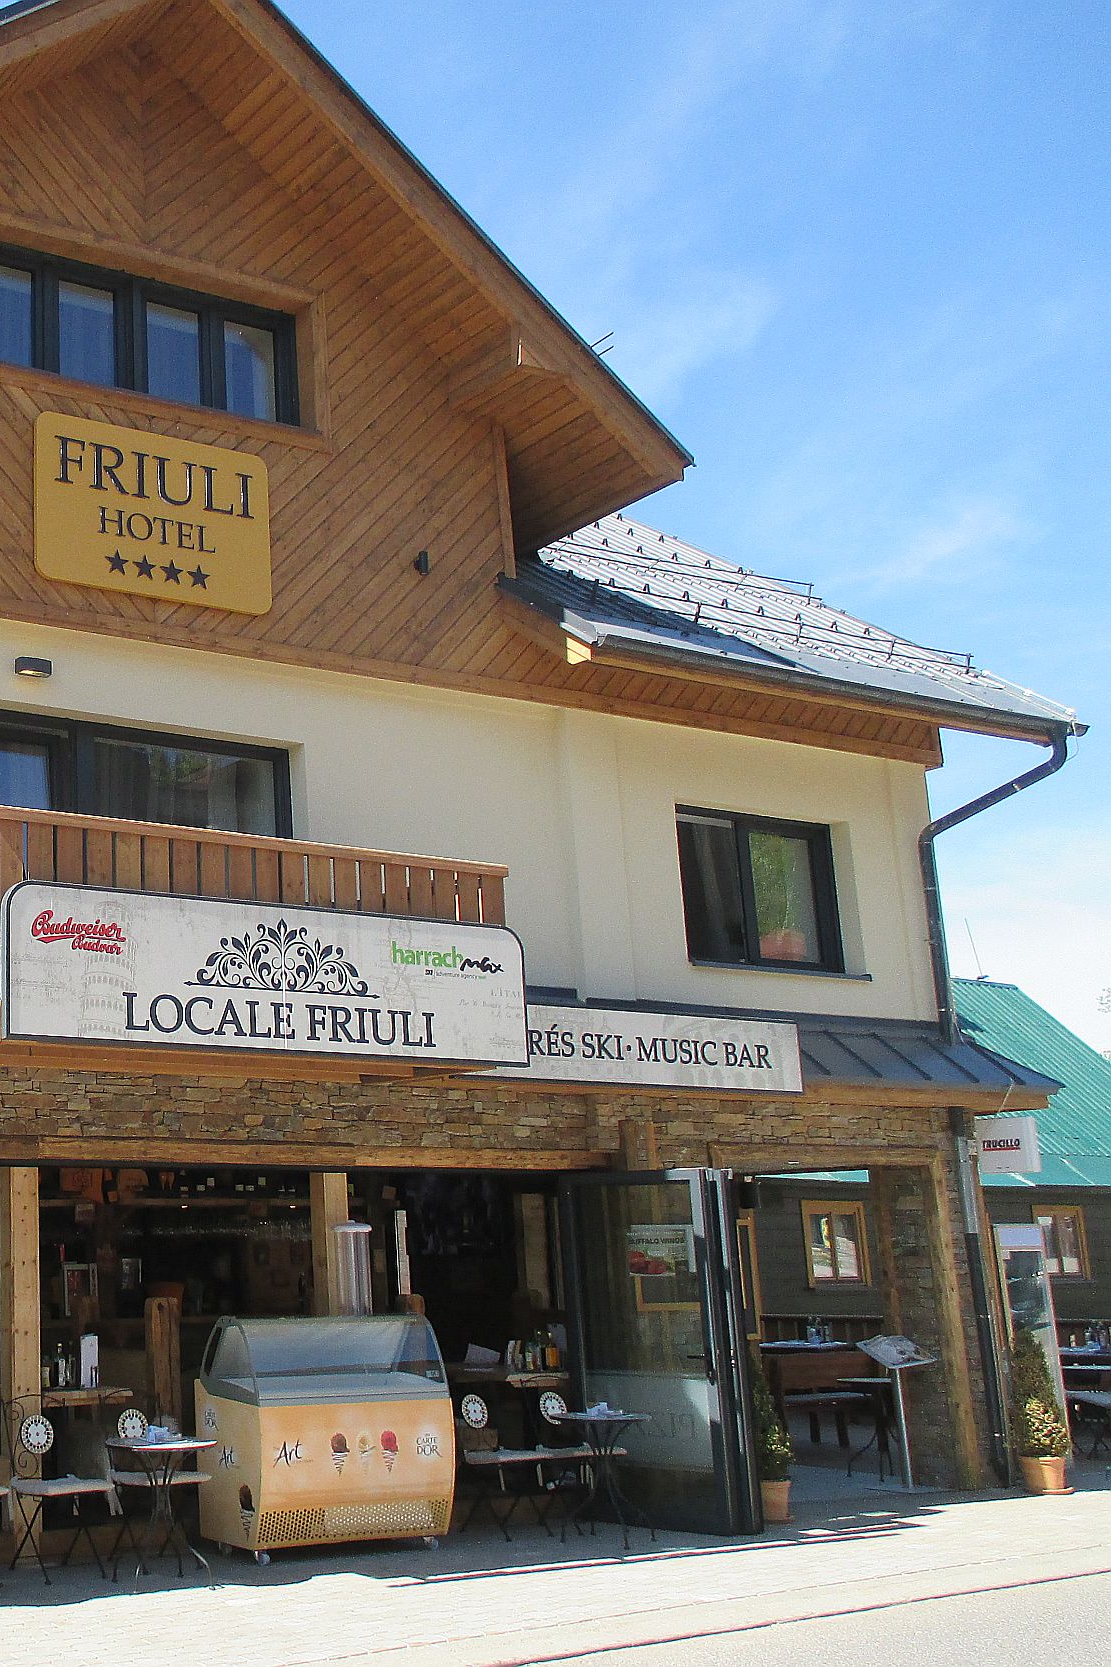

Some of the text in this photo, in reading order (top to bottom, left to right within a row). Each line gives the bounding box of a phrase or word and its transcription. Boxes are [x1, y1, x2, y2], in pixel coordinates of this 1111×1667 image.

[54, 435, 254, 519] FRIULI
[97, 506, 216, 553] HOTEL
[31, 910, 125, 940] Budweiser
[122, 992, 436, 1047] LOCALE FRIULI
[581, 1032, 624, 1060] SKI
[636, 1037, 717, 1066] MUSIC
[724, 1042, 772, 1069] BAR
[983, 1138, 1020, 1149] TRUCILLO
[273, 1438, 302, 1468] Art
